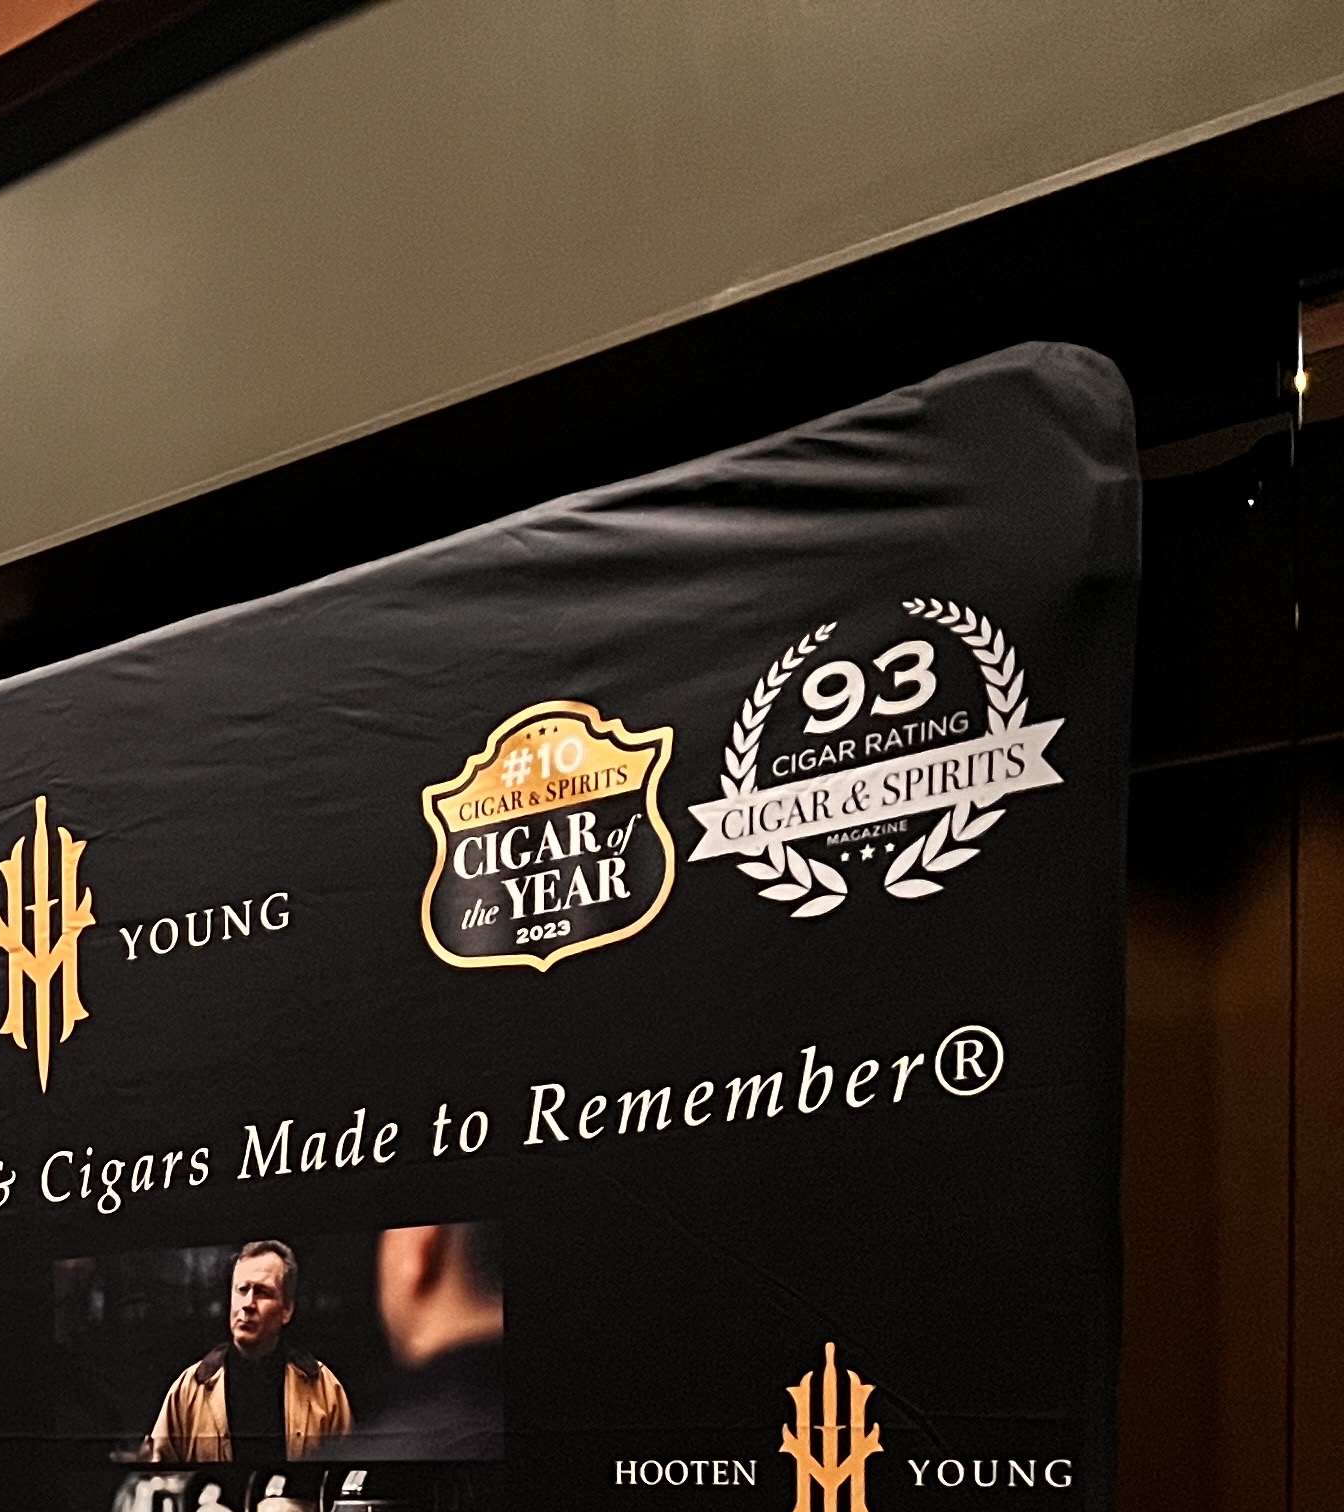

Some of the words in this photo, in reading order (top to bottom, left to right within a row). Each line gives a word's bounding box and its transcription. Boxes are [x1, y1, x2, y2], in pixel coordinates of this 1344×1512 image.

[802, 639, 937, 734] 93
[501, 736, 585, 787] #10
[772, 737, 855, 778] CIGAR
[864, 710, 969, 756] RATING
[459, 790, 523, 822] CIGAR
[528, 791, 540, 806] &
[545, 764, 628, 803] SPIRITS
[720, 789, 833, 841] CIGAR
[841, 780, 871, 815] &
[882, 742, 1026, 807] SPIRITS
[453, 811, 601, 880] CIGAR
[607, 813, 642, 856] of
[826, 819, 908, 846] MAGAZINE
[119, 892, 291, 961] YOUNG
[461, 899, 500, 930] the
[501, 857, 631, 921] YEAR
[516, 920, 571, 944] 2023
[39, 1137, 211, 1214] Cigars
[236, 1107, 399, 1180] Made
[432, 1103, 489, 1155] to
[615, 1460, 757, 1486] HOOTEN
[908, 1459, 1073, 1488] YOUNG
